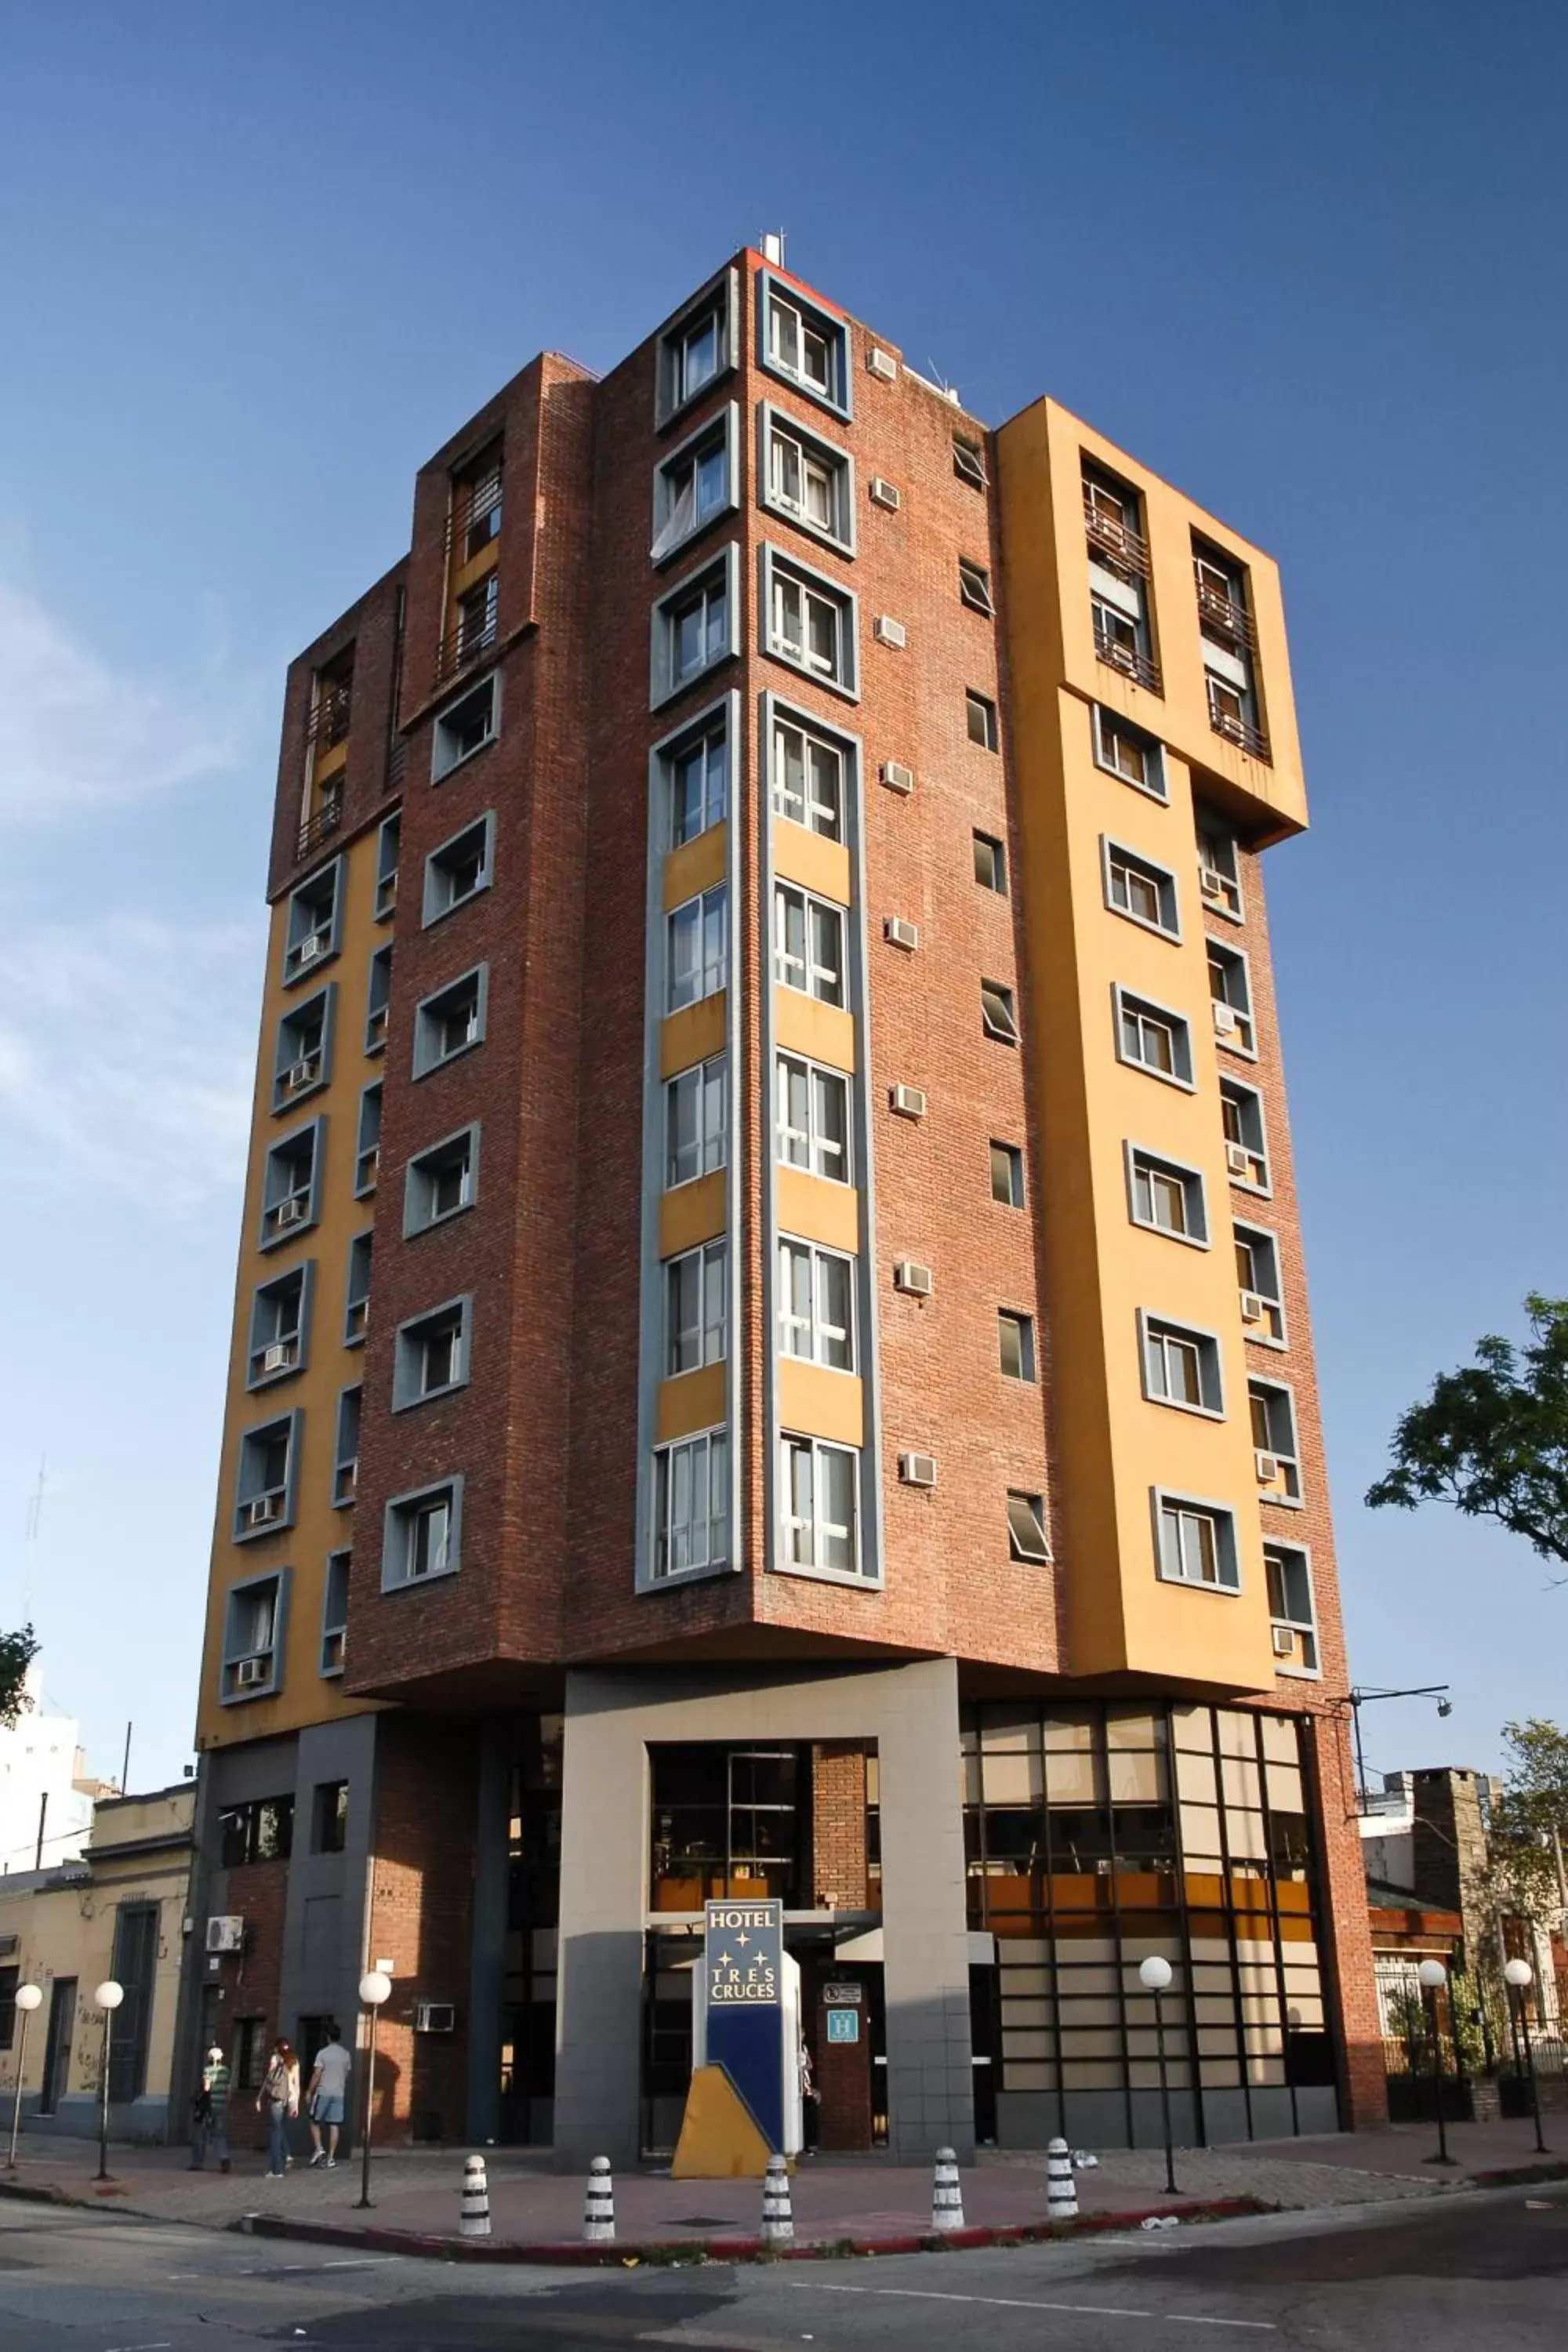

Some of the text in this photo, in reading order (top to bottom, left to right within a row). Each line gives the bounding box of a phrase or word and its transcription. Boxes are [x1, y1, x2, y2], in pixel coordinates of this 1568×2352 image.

[710, 1911, 774, 1927] HOTEL
[712, 1968, 774, 1982] TRES
[712, 1984, 774, 1998] CRUCES
[835, 2020, 849, 2033] H
